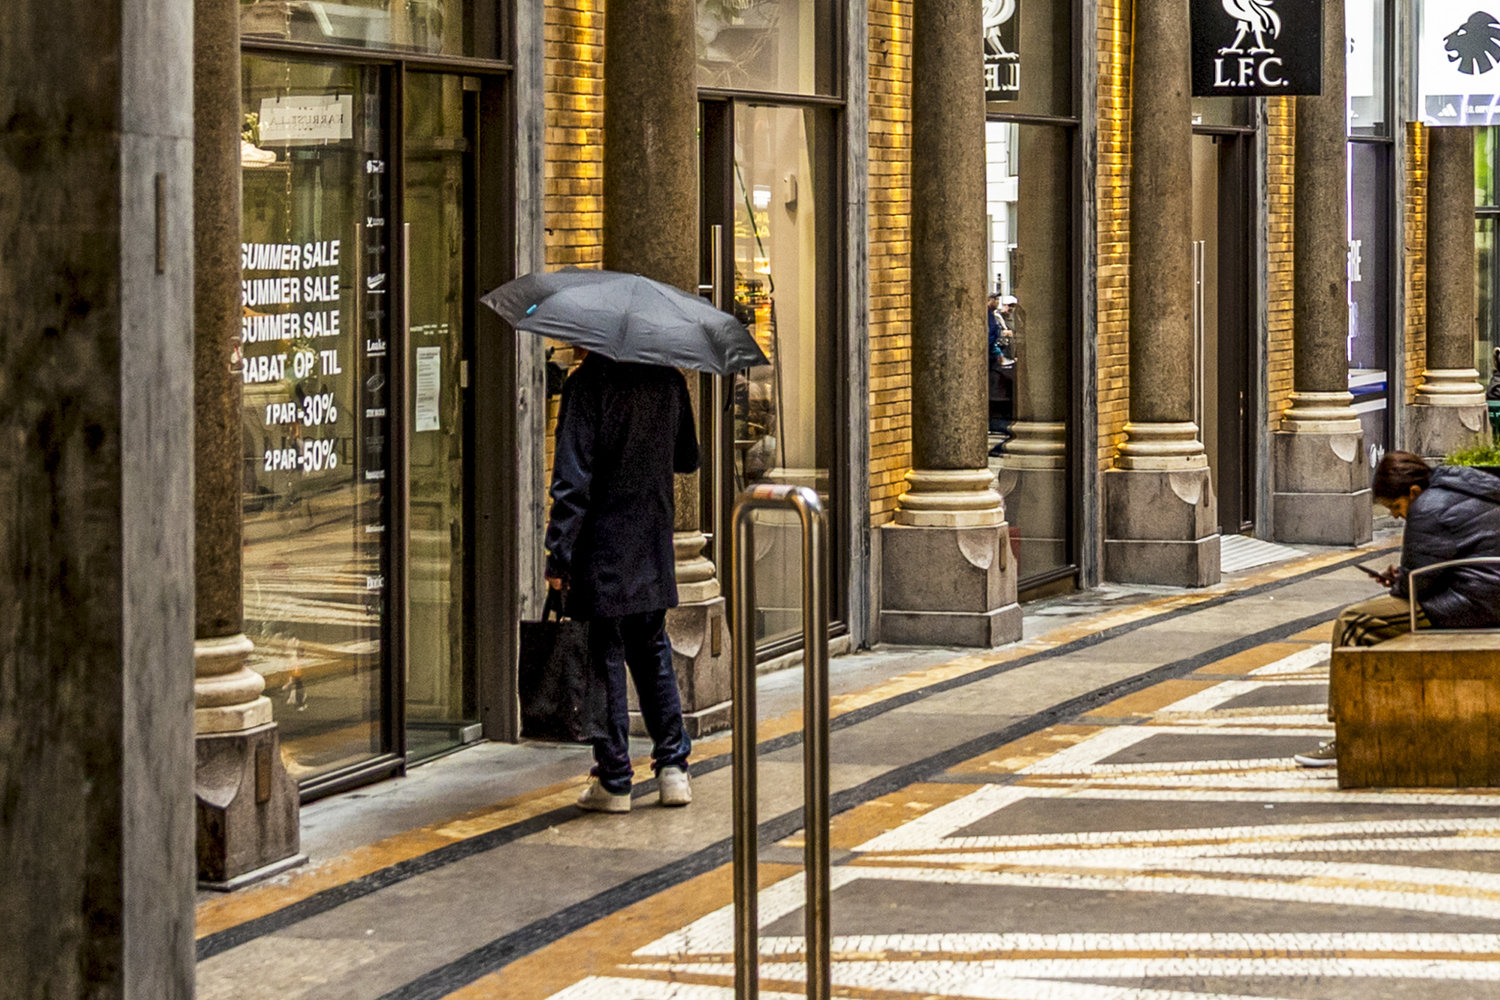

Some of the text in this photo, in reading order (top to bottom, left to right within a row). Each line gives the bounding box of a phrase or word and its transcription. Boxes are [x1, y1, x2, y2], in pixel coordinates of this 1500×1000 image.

[1213, 58, 1288, 87] L.F.C.
[241, 240, 341, 271] SUMMER SALE
[241, 277, 301, 306] SUMMER
[303, 275, 340, 302] SALE
[241, 310, 340, 343] SUMMER SALE
[242, 350, 342, 383] RABAT OP TIL
